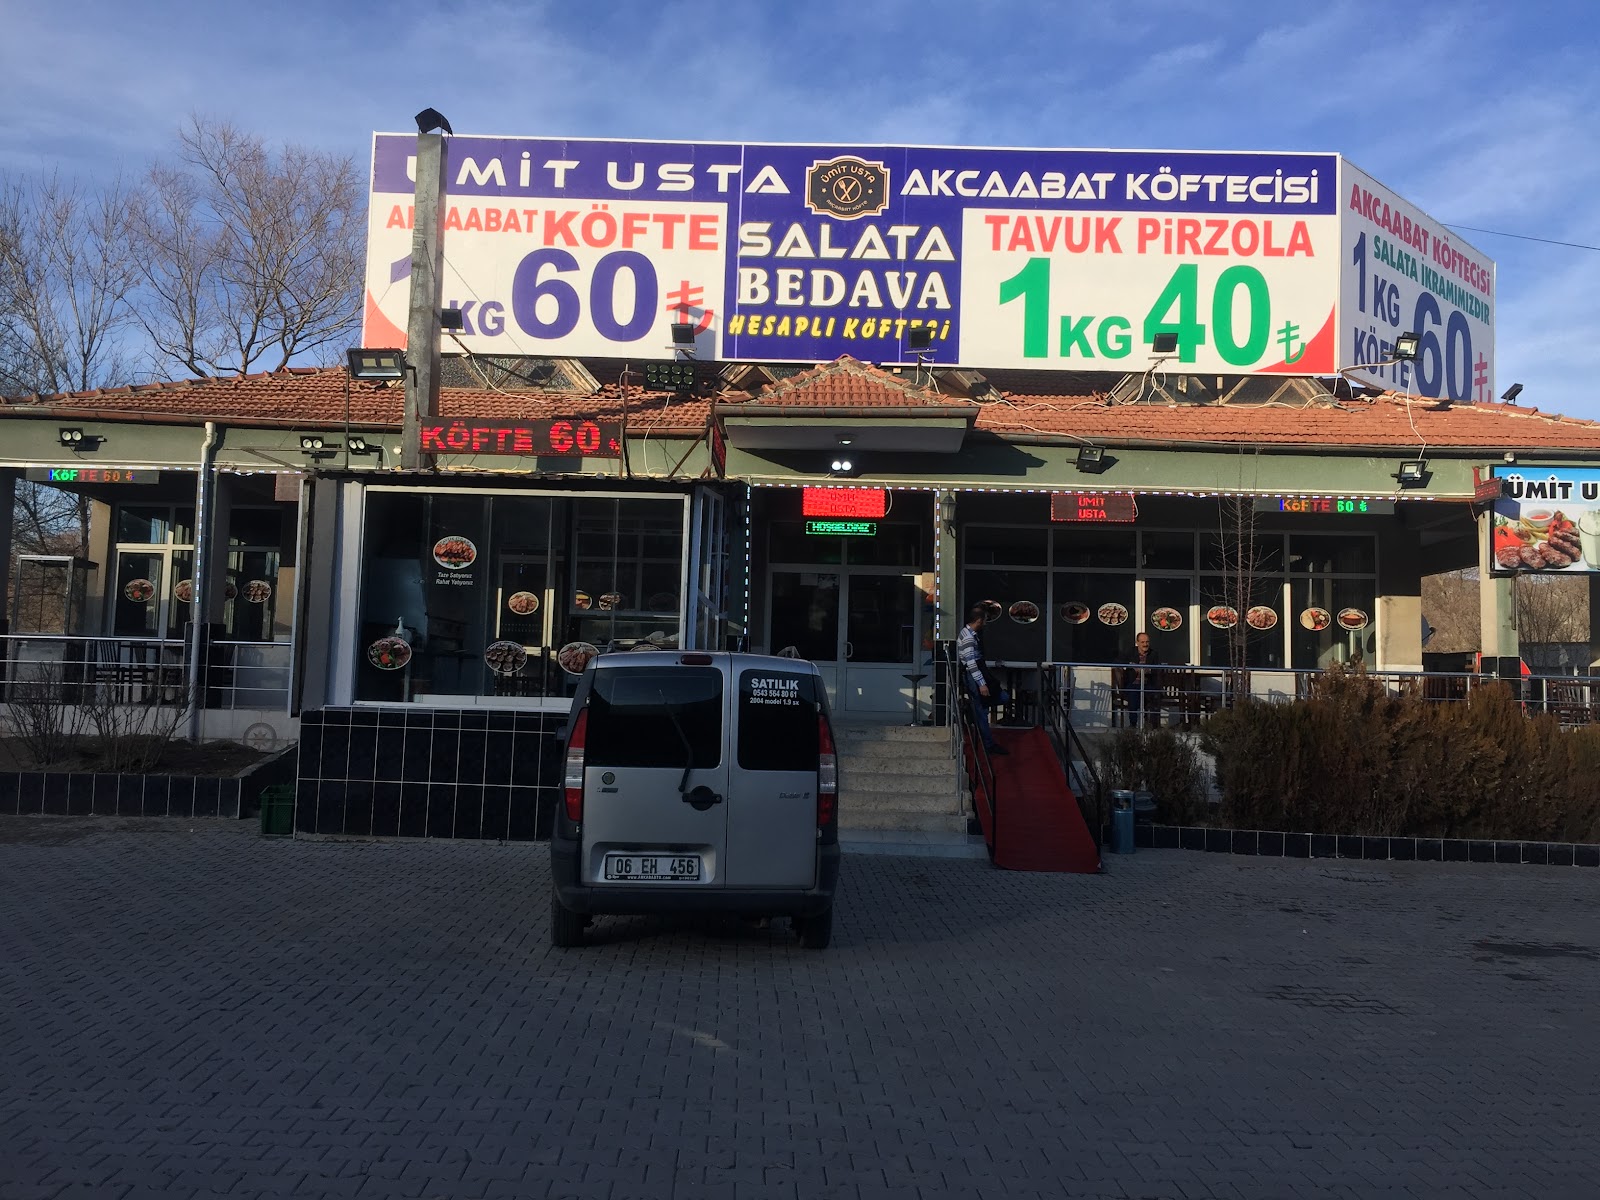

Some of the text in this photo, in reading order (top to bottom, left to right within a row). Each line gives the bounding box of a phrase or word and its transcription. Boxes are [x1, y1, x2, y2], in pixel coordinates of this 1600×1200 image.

[407, 151, 791, 194] MİT USTA
[850, 165, 876, 183] USTA
[900, 166, 1319, 203] AKCAABAT KÖFTECİSİ
[386, 203, 719, 251] AAABAT KÖFTE
[985, 214, 1124, 254] TAVUK
[1349, 183, 1429, 256] AKCAABAT
[737, 222, 956, 261] SALATA
[1373, 235, 1418, 282] SALATA
[449, 300, 505, 337] KG
[512, 248, 659, 342] 60
[737, 267, 952, 310] BEDAVA
[1353, 231, 1400, 328] 1 KG
[728, 314, 837, 338] HESAPLI
[999, 257, 1051, 358] 1
[1060, 315, 1132, 358] KG
[1143, 263, 1271, 366] 40
[1413, 291, 1473, 401] 60
[422, 421, 534, 450] KÖFTE
[550, 421, 601, 453] 60
[103, 470, 121, 482] 60
[1508, 474, 1573, 499] ÜMİT
[1078, 509, 1107, 519] USTA
[1337, 500, 1354, 512] 60
[751, 677, 800, 690] SATILIK
[752, 689, 768, 697] 0543
[615, 858, 694, 875] 06 EH 456
